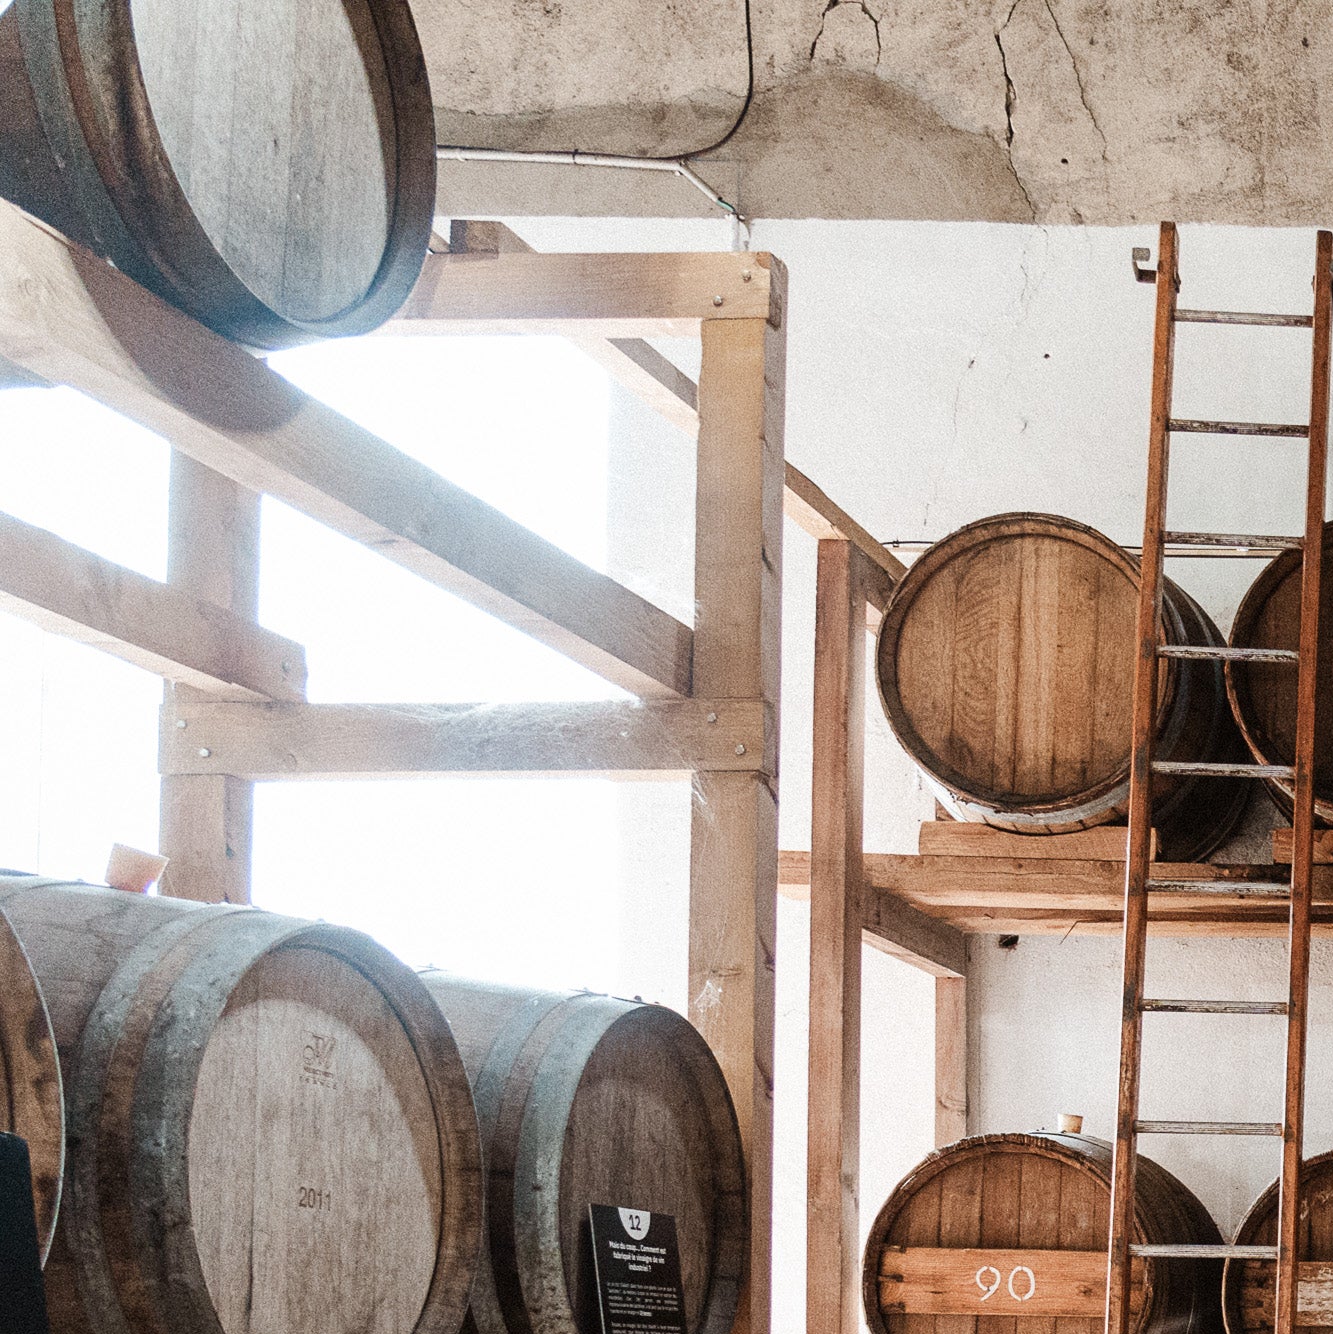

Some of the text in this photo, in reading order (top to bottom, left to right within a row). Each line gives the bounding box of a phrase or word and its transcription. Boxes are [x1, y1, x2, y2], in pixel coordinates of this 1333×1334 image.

[299, 1186, 331, 1211] 2011
[629, 1215, 641, 1231] 12
[975, 1265, 1036, 1302] 90
